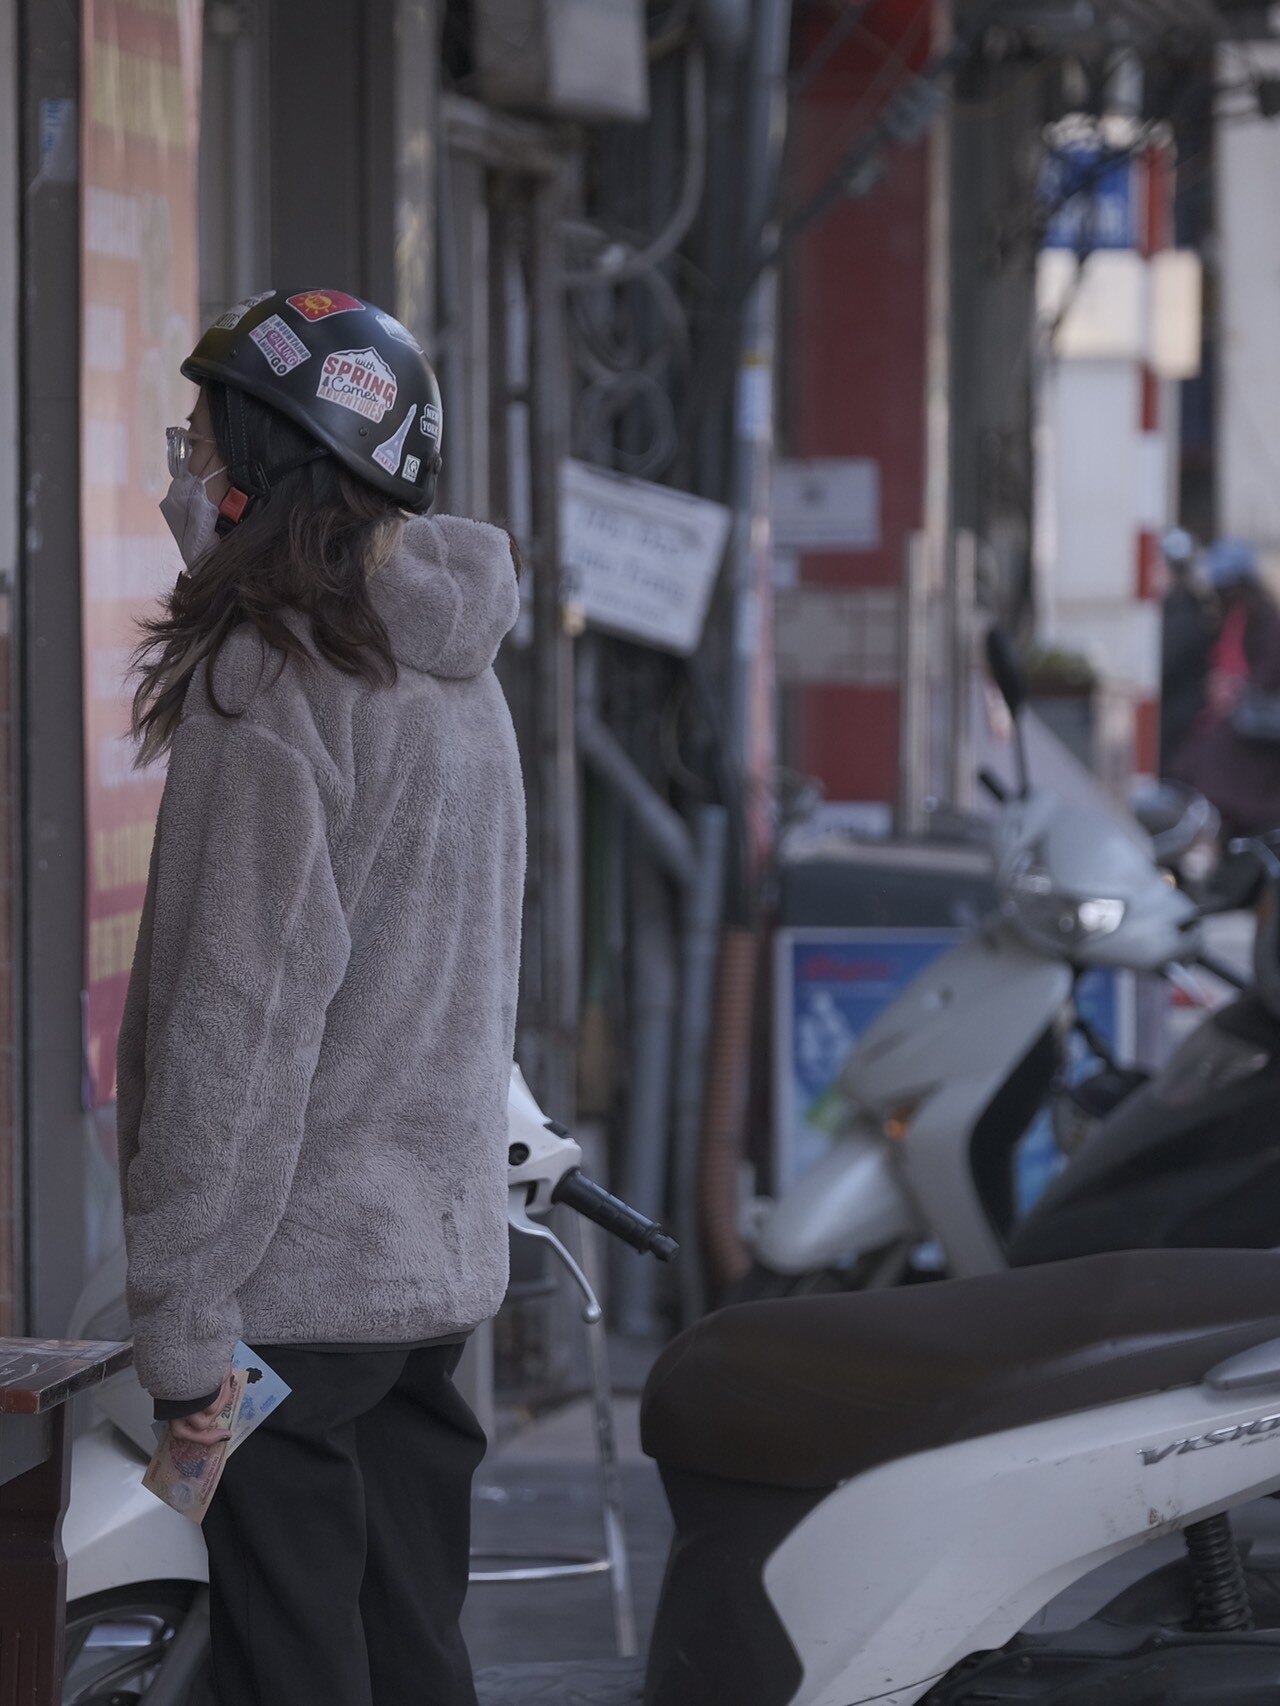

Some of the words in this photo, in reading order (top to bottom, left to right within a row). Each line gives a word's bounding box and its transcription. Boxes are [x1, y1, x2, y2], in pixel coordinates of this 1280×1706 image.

[270, 332, 299, 366] CALLING
[270, 357, 287, 374] GO
[355, 358, 376, 372] with
[324, 356, 396, 408] SPRING
[332, 376, 379, 402] Comes
[318, 387, 386, 421] ADVENTURES
